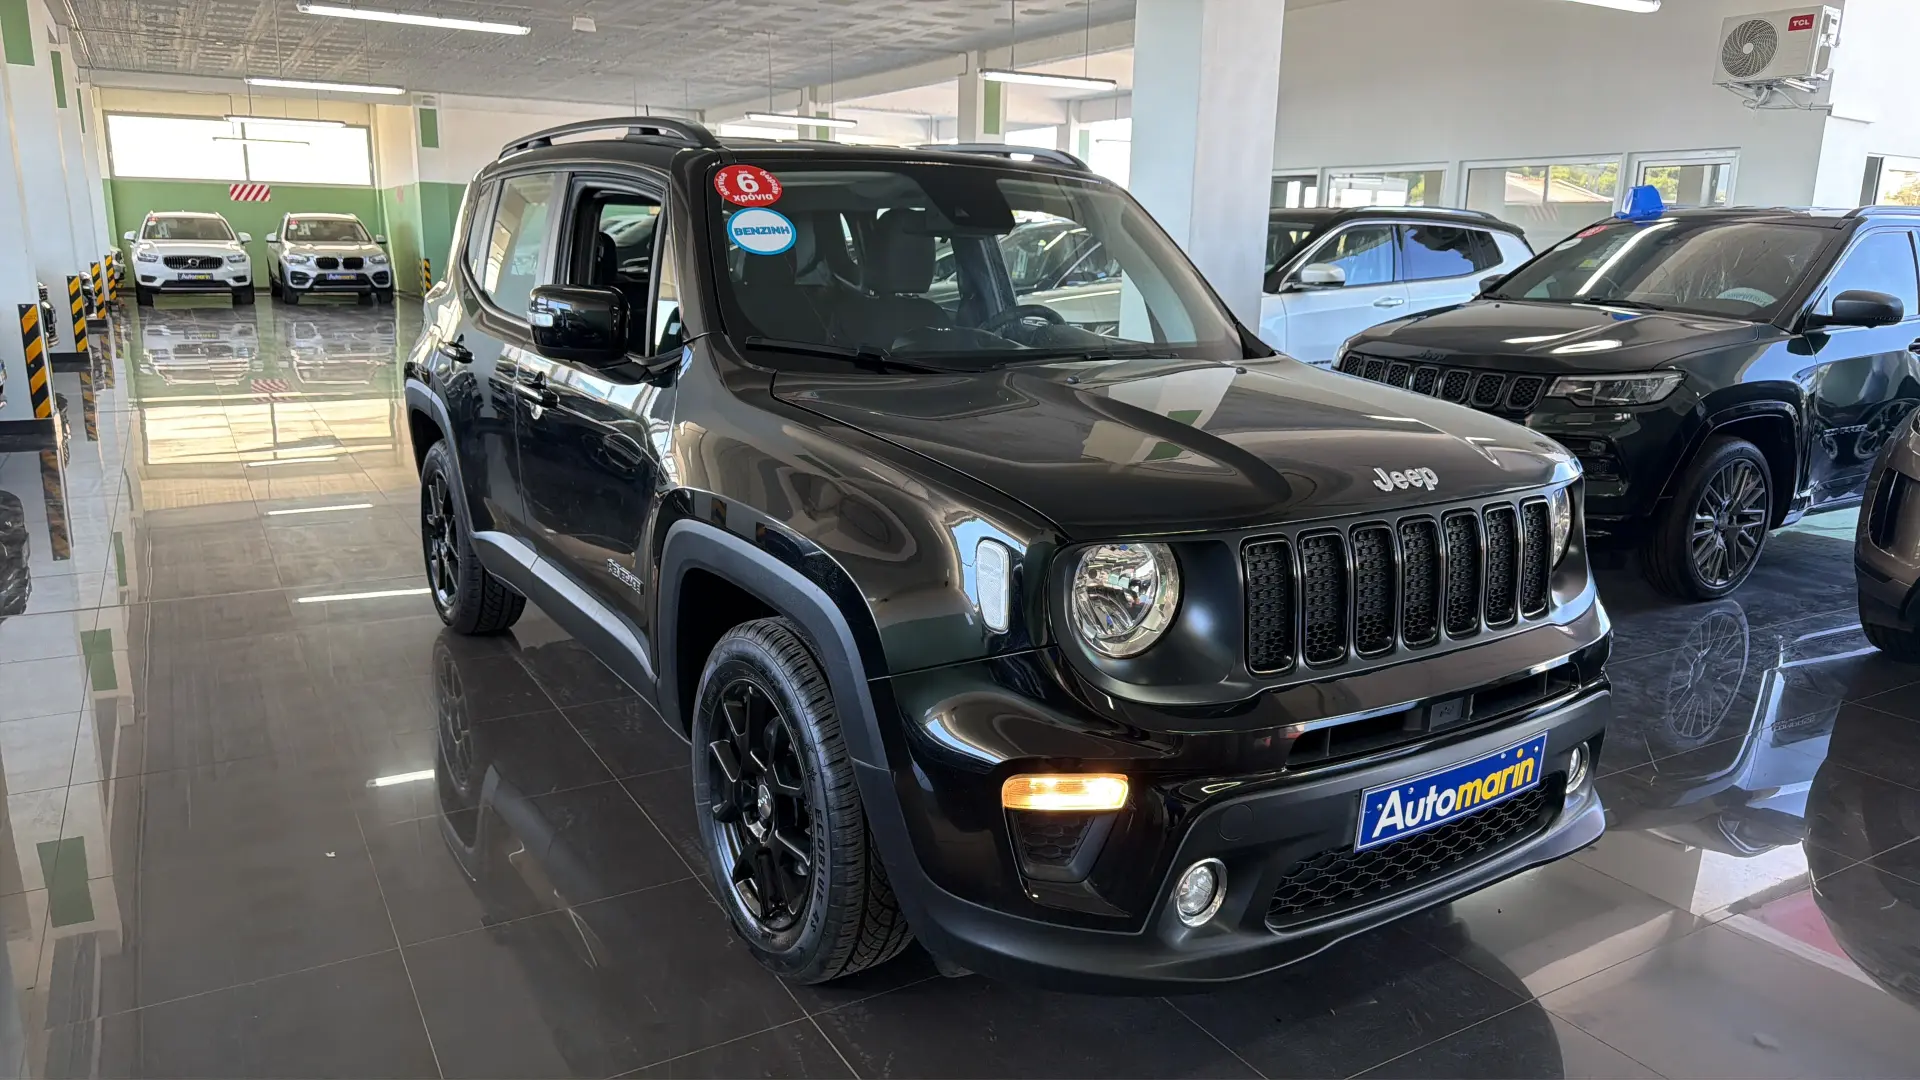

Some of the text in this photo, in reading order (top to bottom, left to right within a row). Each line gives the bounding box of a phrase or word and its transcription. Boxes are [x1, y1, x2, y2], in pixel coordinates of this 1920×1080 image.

[1792, 19, 1810, 27] TCL
[736, 173, 760, 193] 6
[732, 193, 774, 203] χρόνια
[1373, 467, 1439, 492] Jeep
[1371, 748, 1534, 839] Automarin
[815, 808, 825, 907] ECOBLUE
